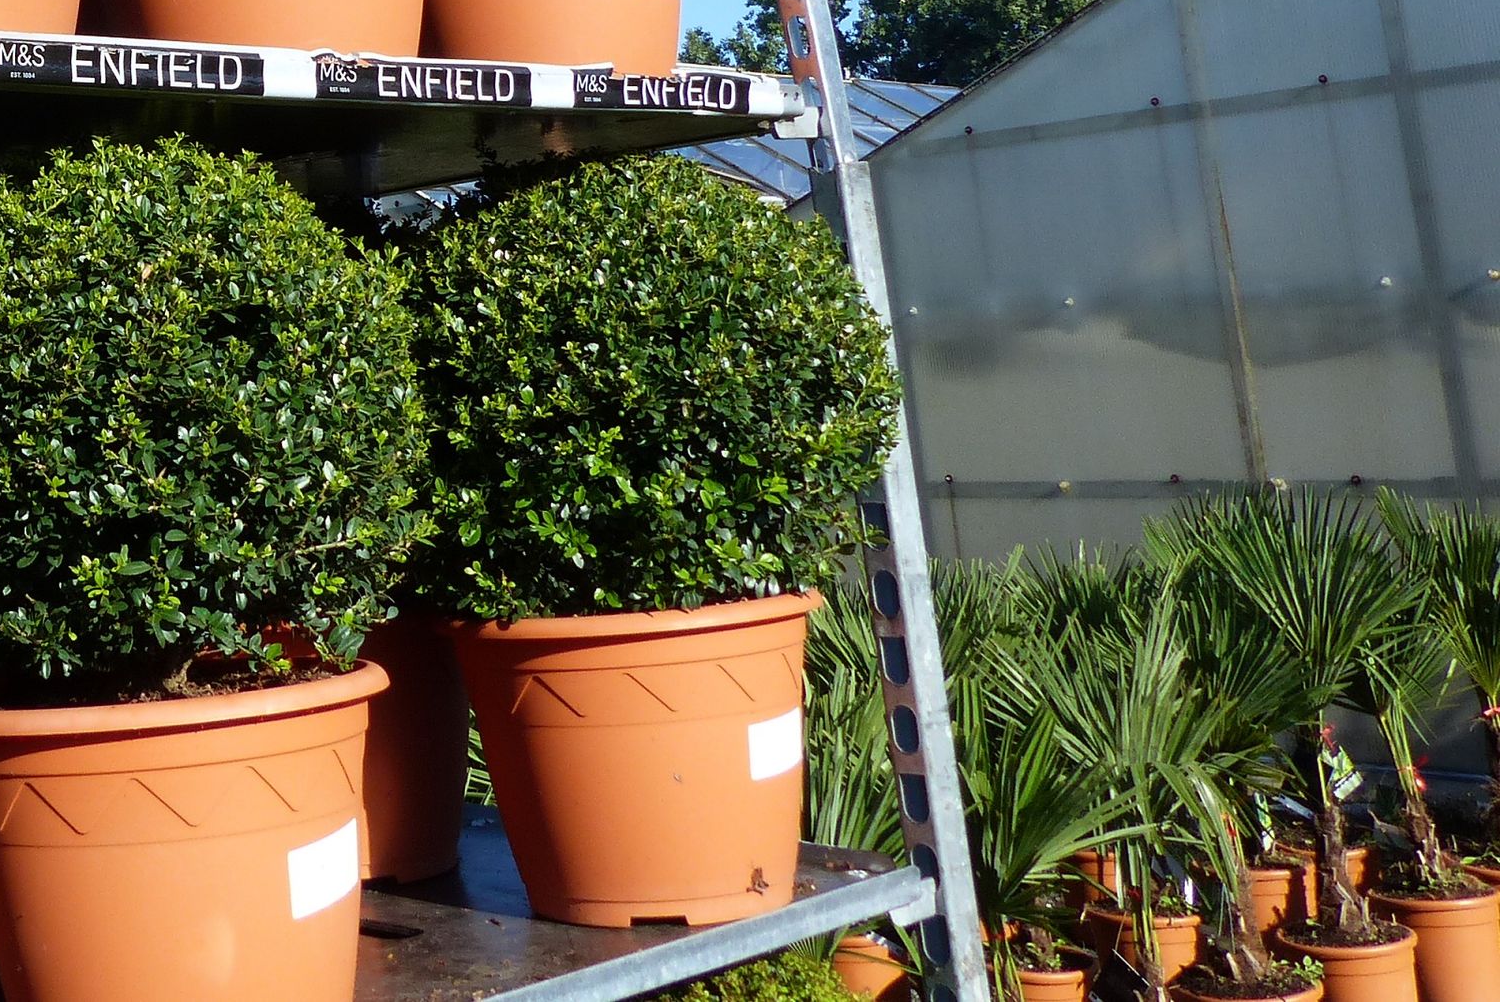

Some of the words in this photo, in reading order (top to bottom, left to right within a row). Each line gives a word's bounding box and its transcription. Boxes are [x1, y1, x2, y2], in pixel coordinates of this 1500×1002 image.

[0, 43, 45, 68] M&S
[71, 44, 243, 90] ENFIELD
[320, 61, 357, 83] M&S
[378, 65, 514, 102] ENFIELD
[576, 74, 607, 93] M&S
[624, 76, 736, 110] ENFIELD
